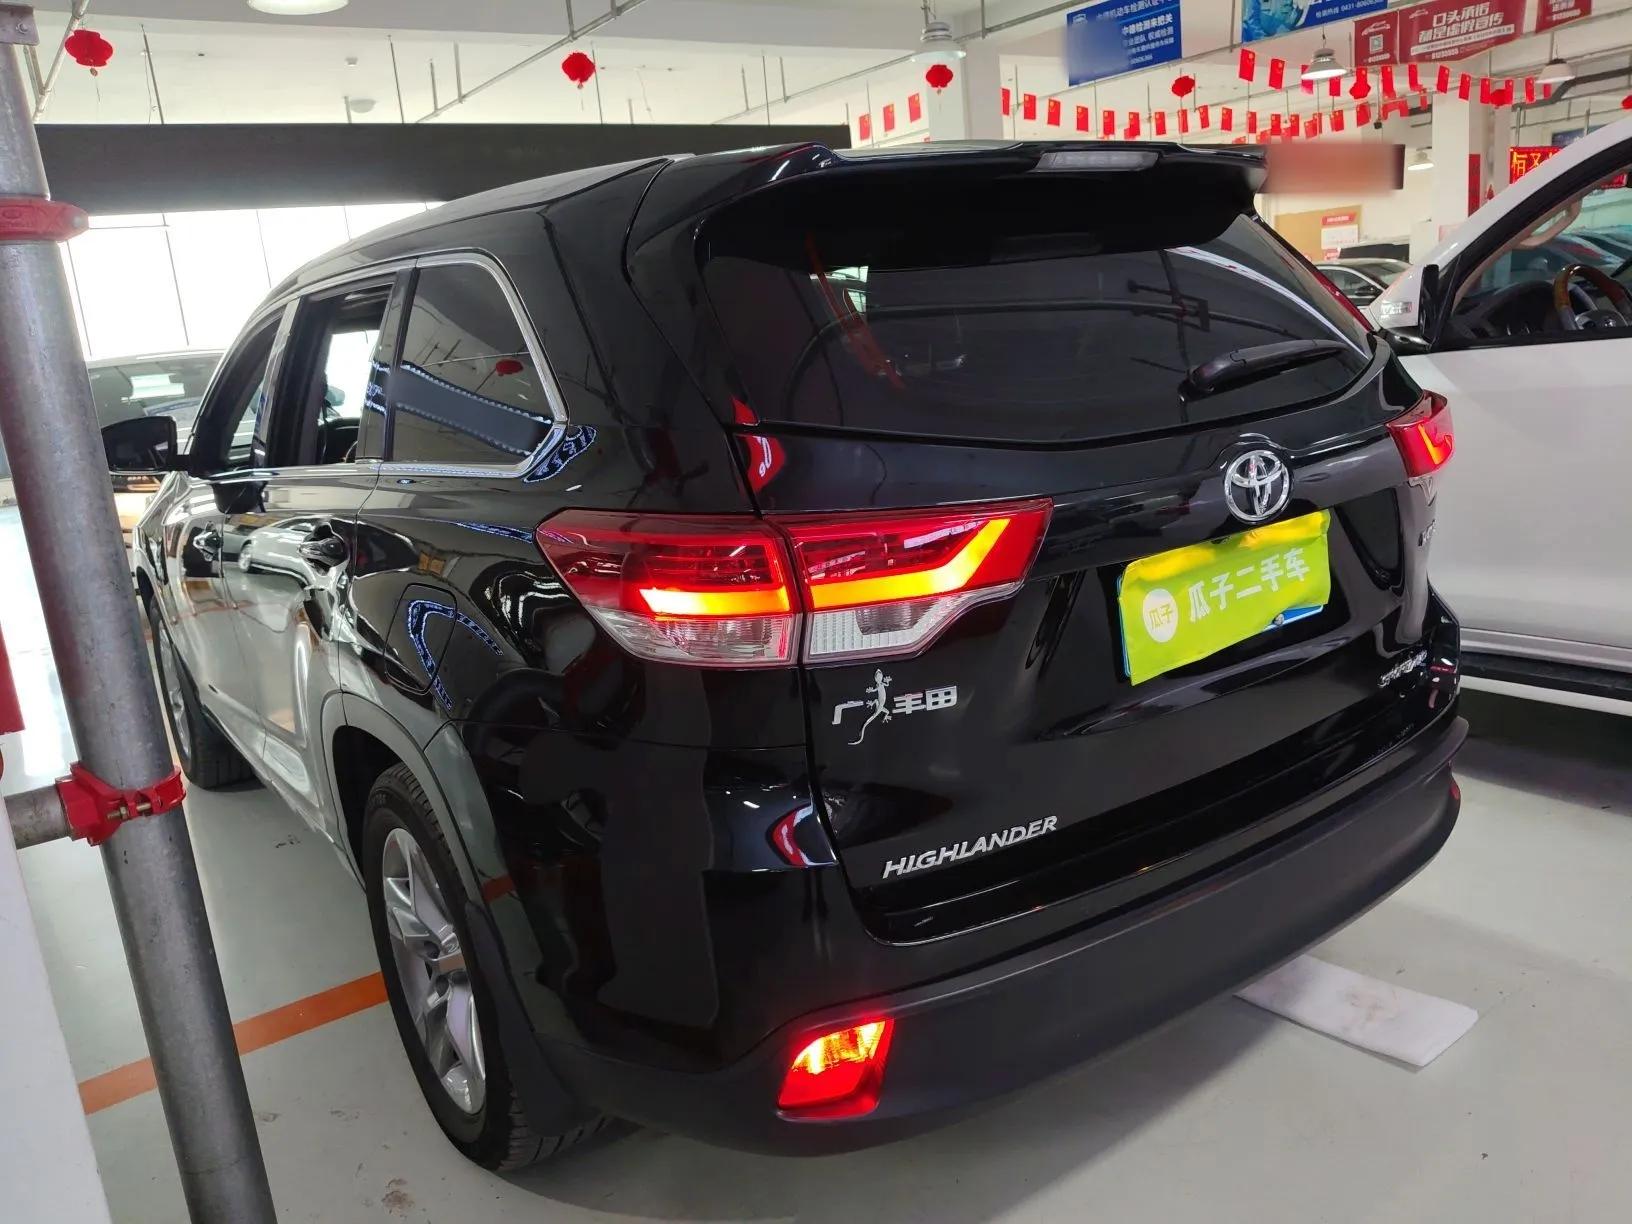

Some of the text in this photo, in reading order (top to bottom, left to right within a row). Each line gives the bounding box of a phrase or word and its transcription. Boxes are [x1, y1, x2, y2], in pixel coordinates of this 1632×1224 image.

[1418, 12, 1504, 43] 都是虚假宣传
[1433, 2, 1490, 27] 口头承诺
[1188, 548, 1310, 623] 瓜子二手车
[832, 686, 957, 725] 广丰田
[882, 815, 1058, 879] HIGHLANDER
